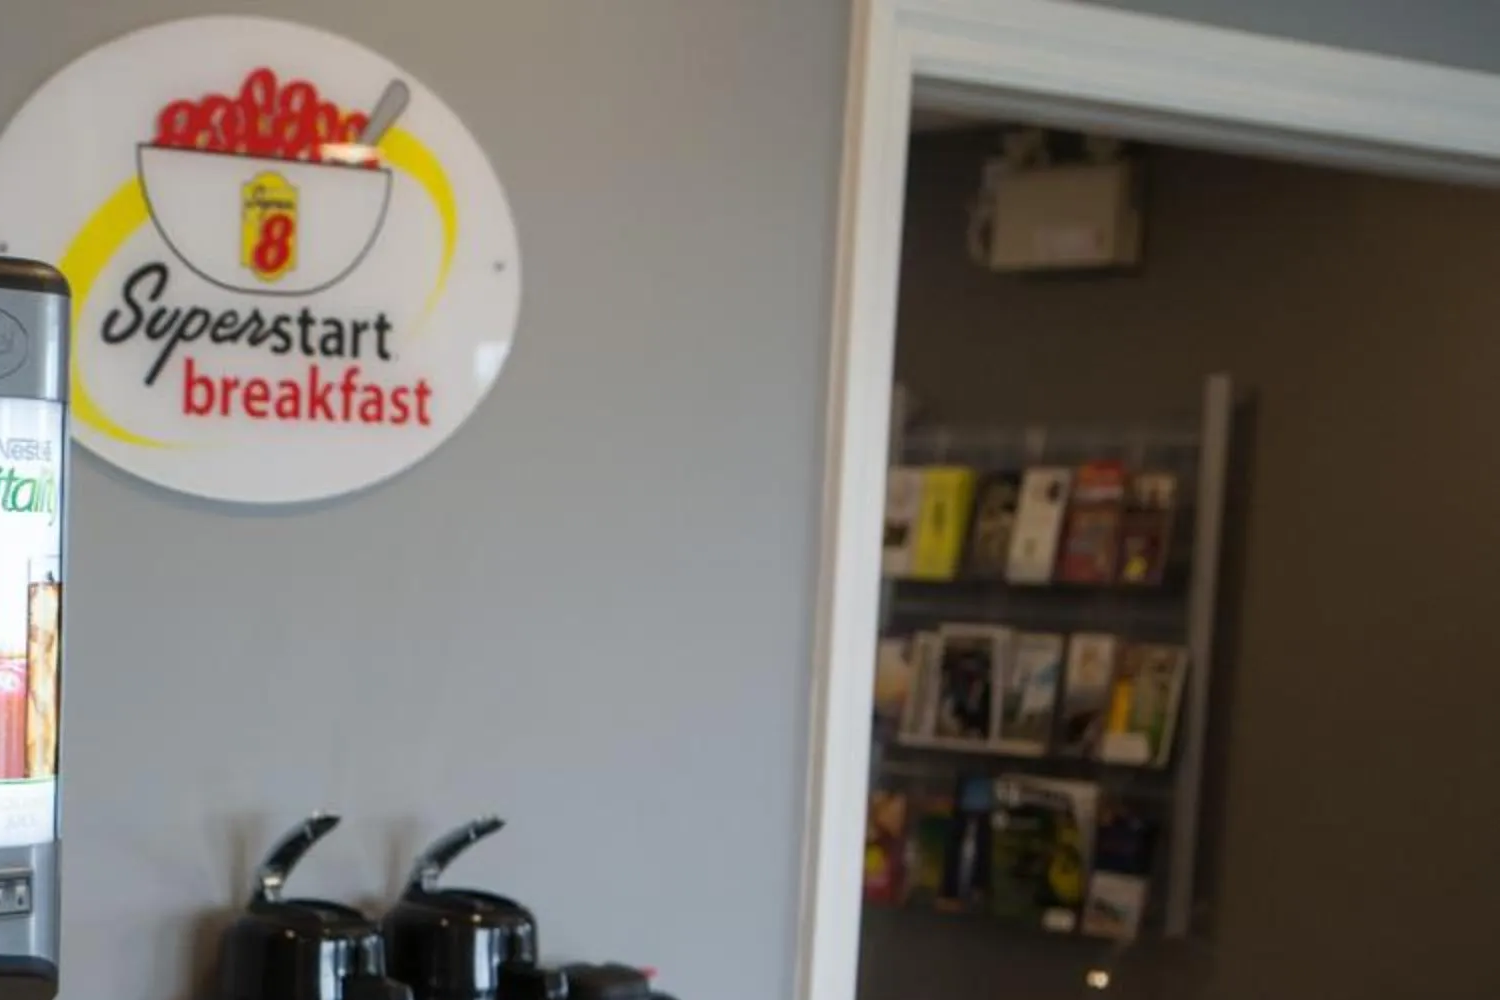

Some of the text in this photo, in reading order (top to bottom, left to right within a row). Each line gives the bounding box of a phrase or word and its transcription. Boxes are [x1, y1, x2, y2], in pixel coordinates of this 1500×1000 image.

[252, 213, 293, 273] 8
[101, 261, 393, 387] Superstart
[182, 356, 433, 427] breakfast
